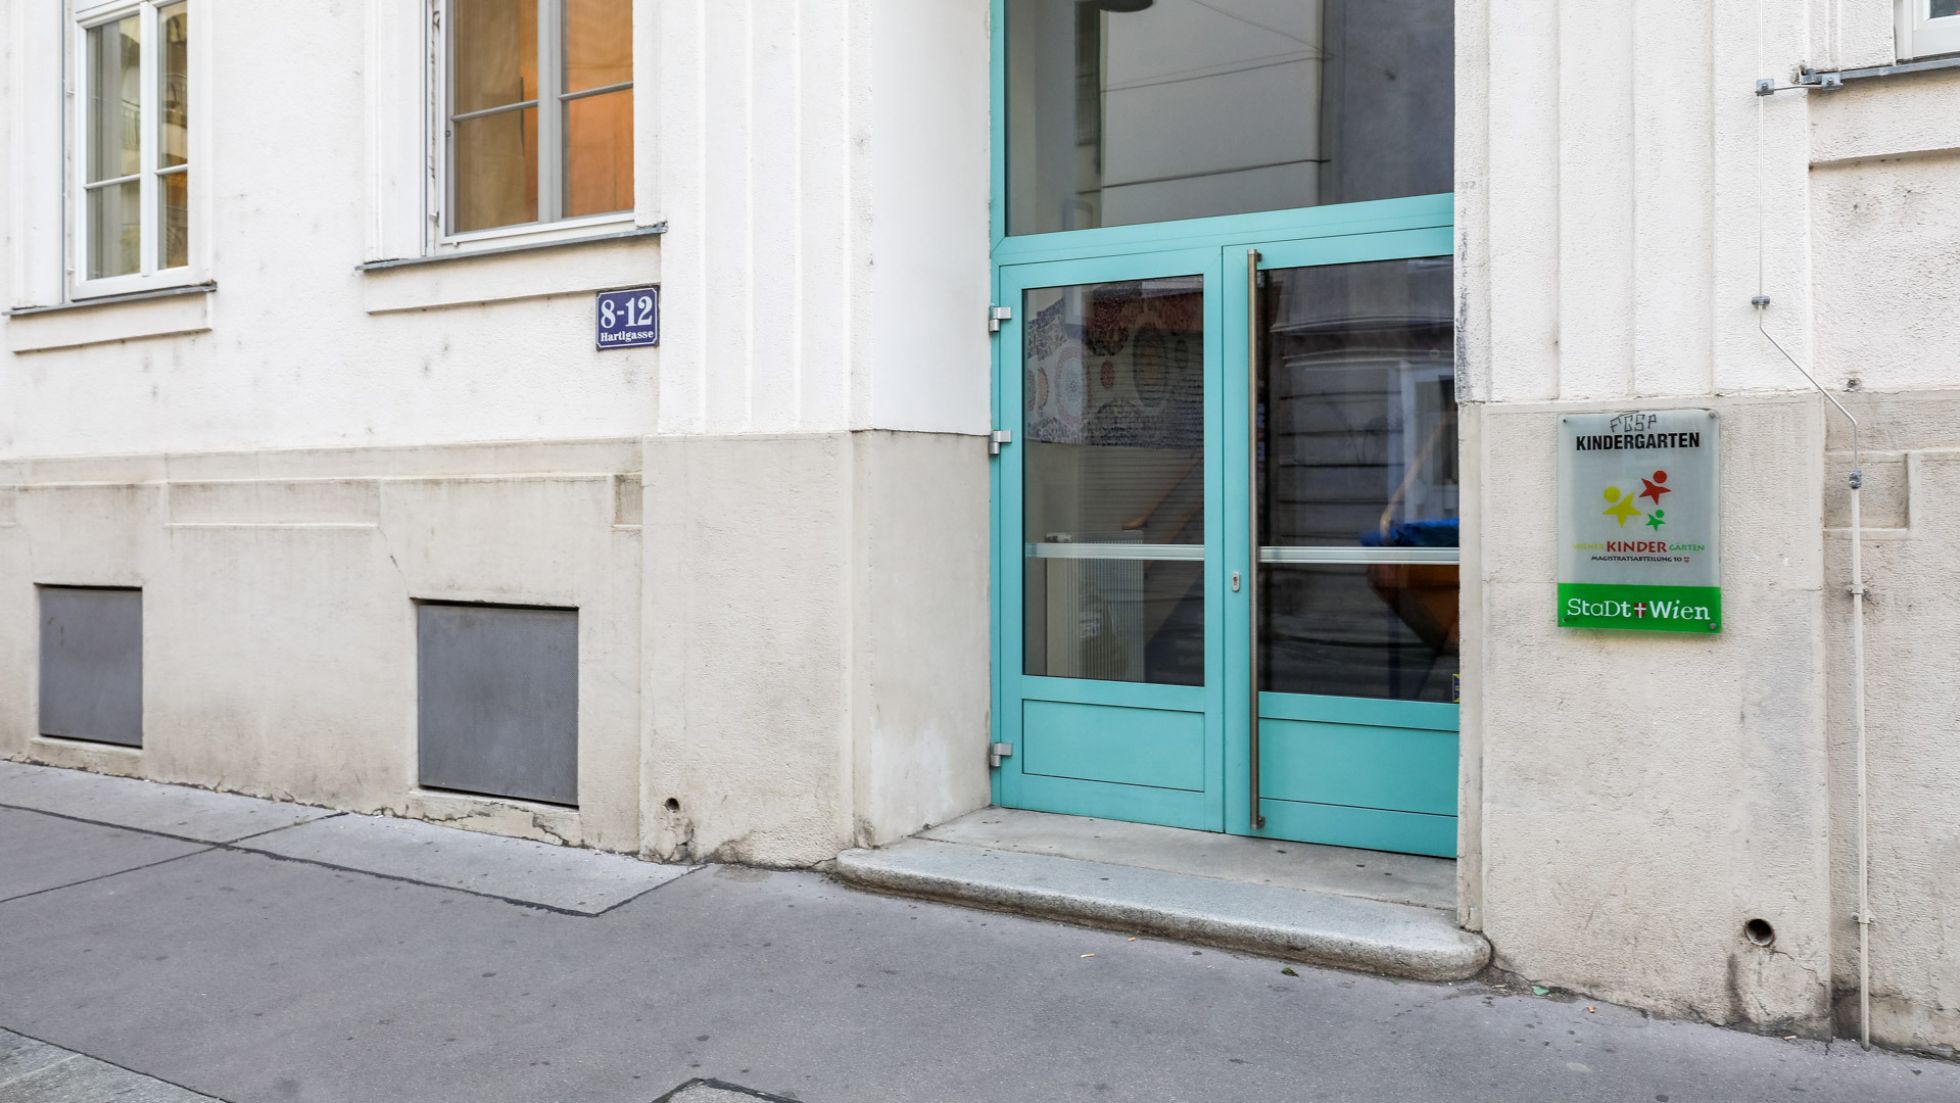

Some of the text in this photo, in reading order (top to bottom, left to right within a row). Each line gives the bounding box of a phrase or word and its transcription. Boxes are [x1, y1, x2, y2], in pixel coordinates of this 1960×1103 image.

[600, 296, 653, 329] 8-12
[600, 331, 654, 342] Hartlgasse
[1576, 432, 1700, 451] KINDERGARTEN
[1606, 541, 1667, 552] KINDER
[1649, 599, 1711, 620] Wien
